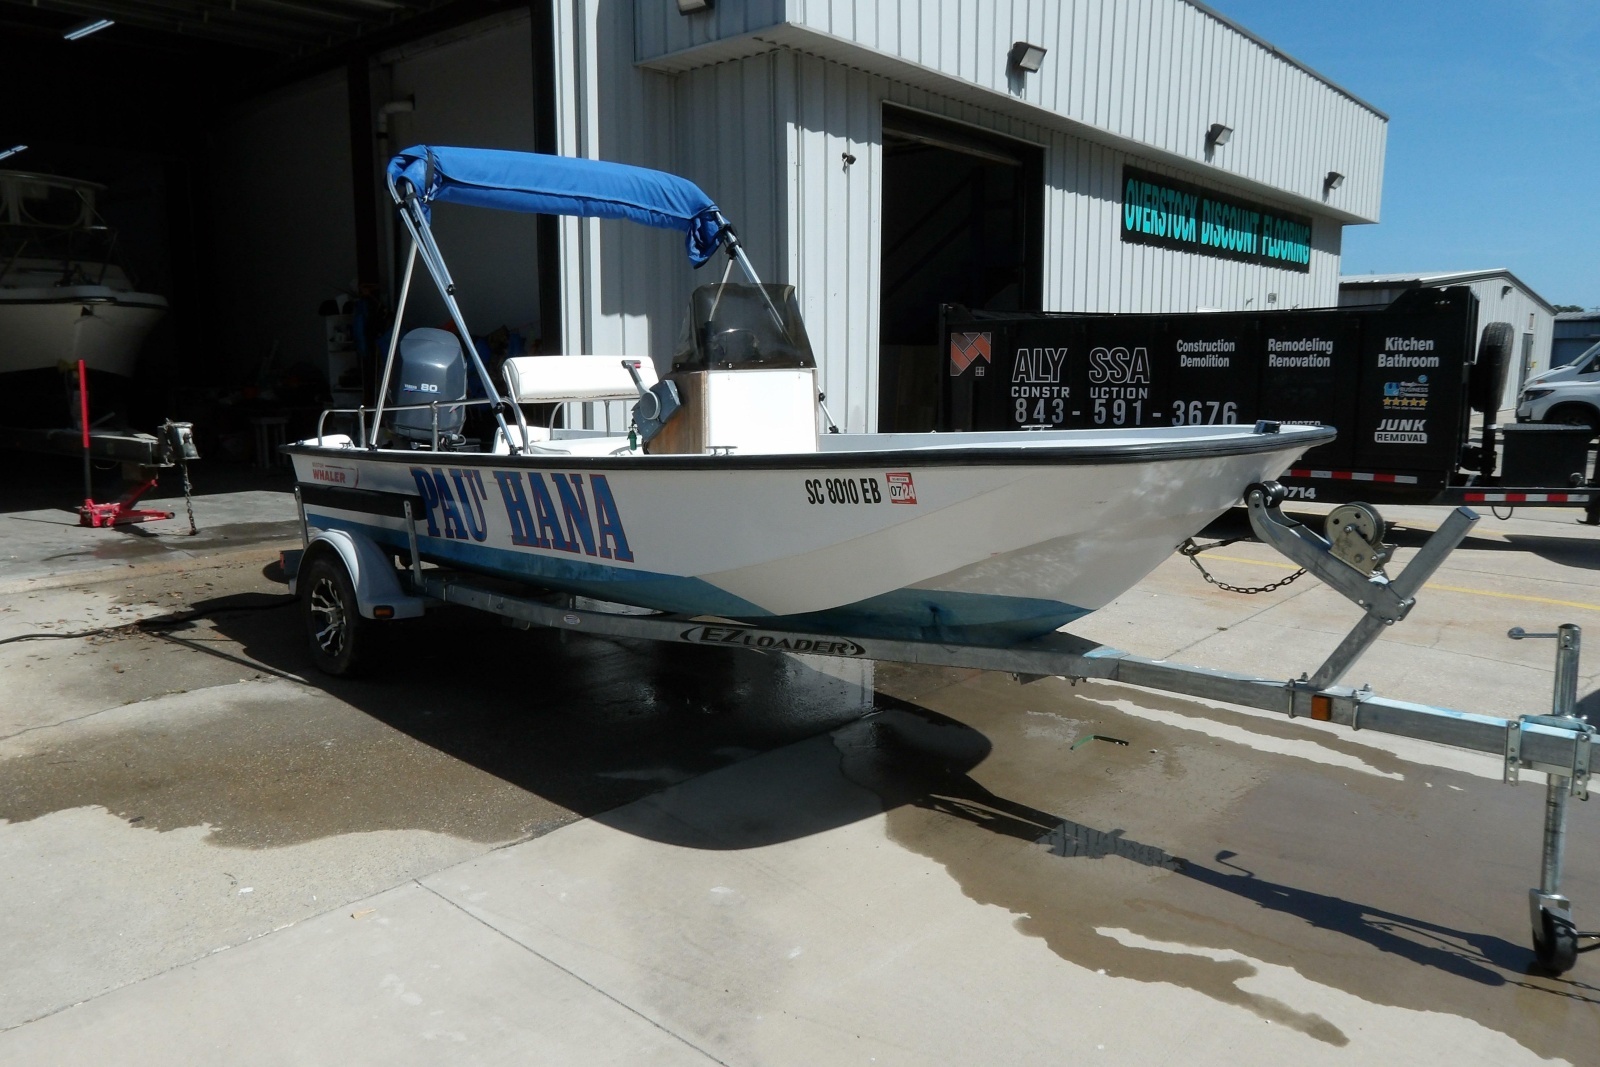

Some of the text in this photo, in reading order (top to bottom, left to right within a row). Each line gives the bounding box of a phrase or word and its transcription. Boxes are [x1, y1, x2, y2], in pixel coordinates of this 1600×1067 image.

[1124, 178, 1310, 265] OVERSTOCK DISCOUNT FLOORING
[1176, 339, 1235, 353] Construction
[1268, 338, 1334, 354] Remodeling
[1385, 337, 1434, 351] Kitchen
[1180, 354, 1230, 368] Demolition
[1268, 354, 1331, 368] Renovation
[1377, 353, 1440, 368] Bathroom
[421, 383, 438, 392] 80
[1011, 386, 1148, 399] CONSTR UCTION
[1376, 419, 1427, 431] JUNK
[1376, 433, 1426, 443] REMOVAL
[312, 469, 346, 484] WHALER
[805, 478, 882, 504] SC 8010 EB
[890, 485, 902, 497] 07
[493, 470, 634, 563] HANA
